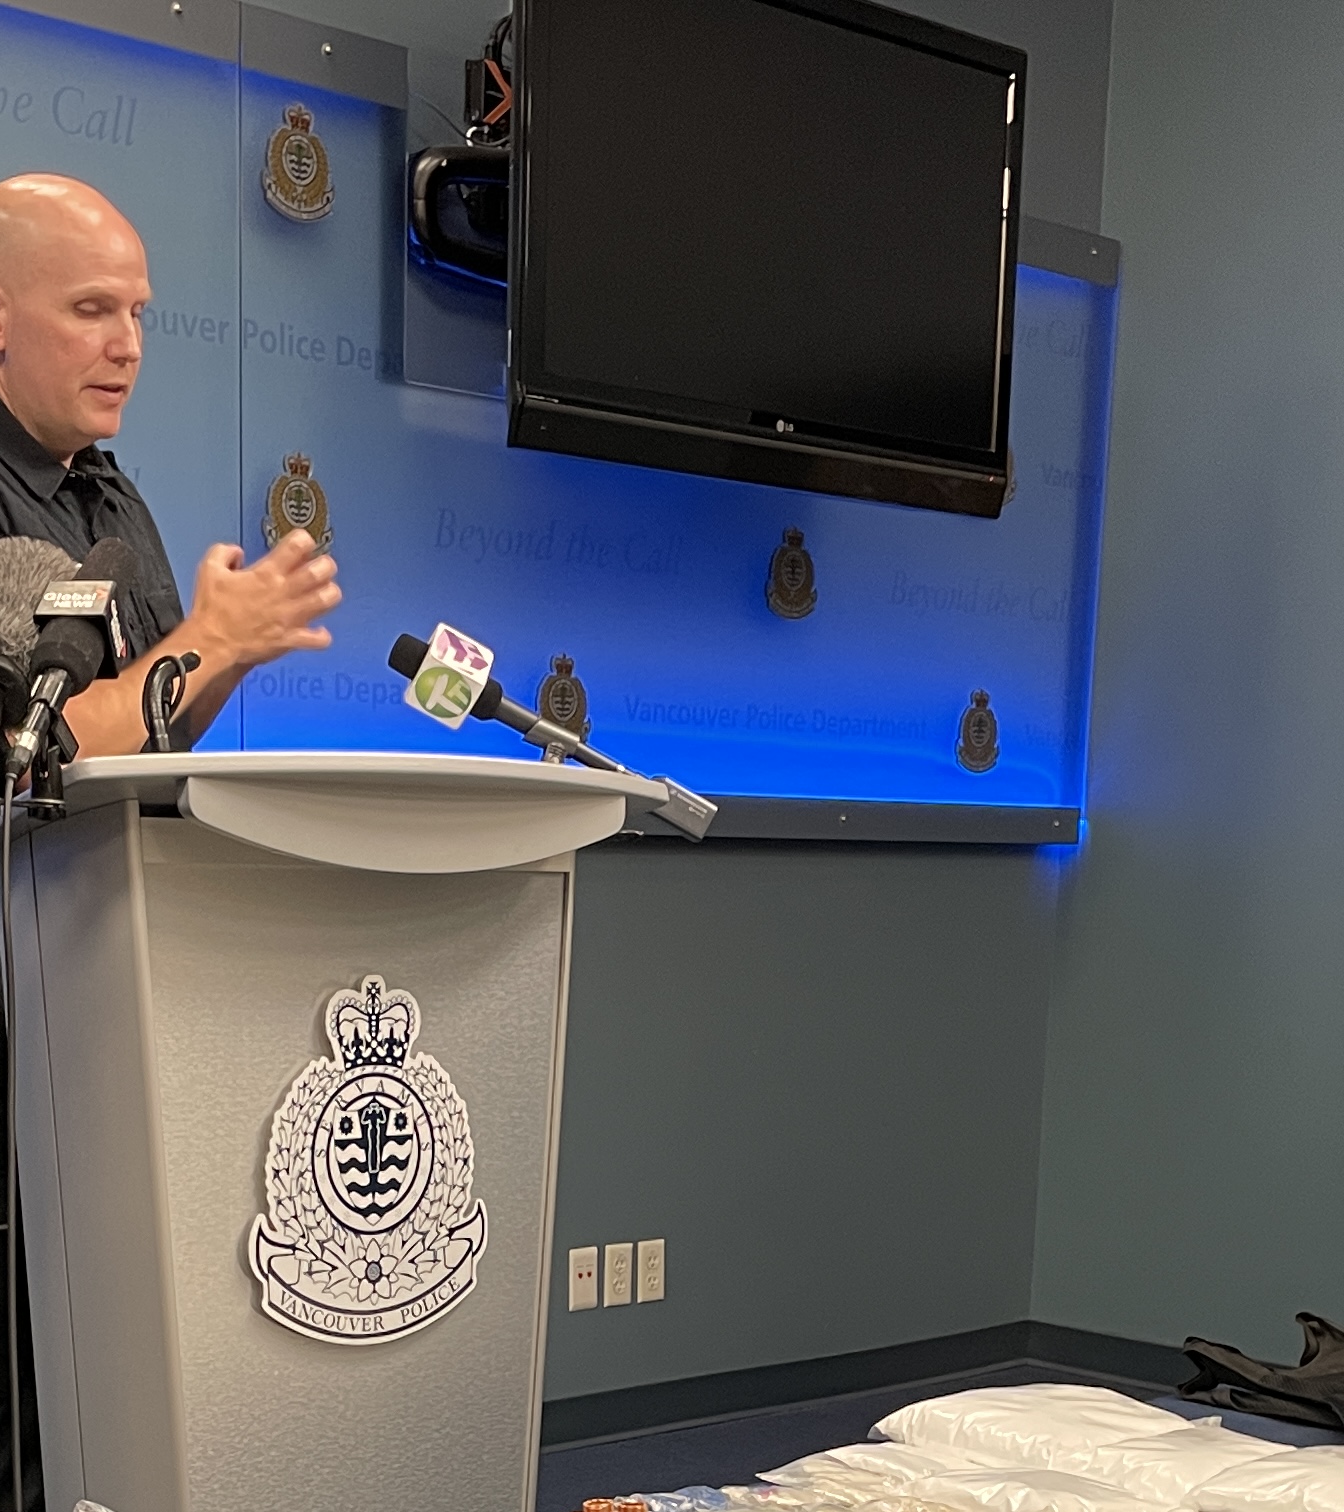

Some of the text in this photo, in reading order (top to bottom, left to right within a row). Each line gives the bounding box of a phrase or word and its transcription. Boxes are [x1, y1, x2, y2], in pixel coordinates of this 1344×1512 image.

[51, 86, 137, 147] Call
[142, 305, 230, 346] ouver
[242, 317, 327, 363] Police
[434, 506, 556, 565] Beyond
[565, 524, 611, 570] the
[245, 665, 325, 699] Police
[623, 694, 929, 742] Vancouver Police Department
[277, 1278, 462, 1334] VANCOUVER POLICE
